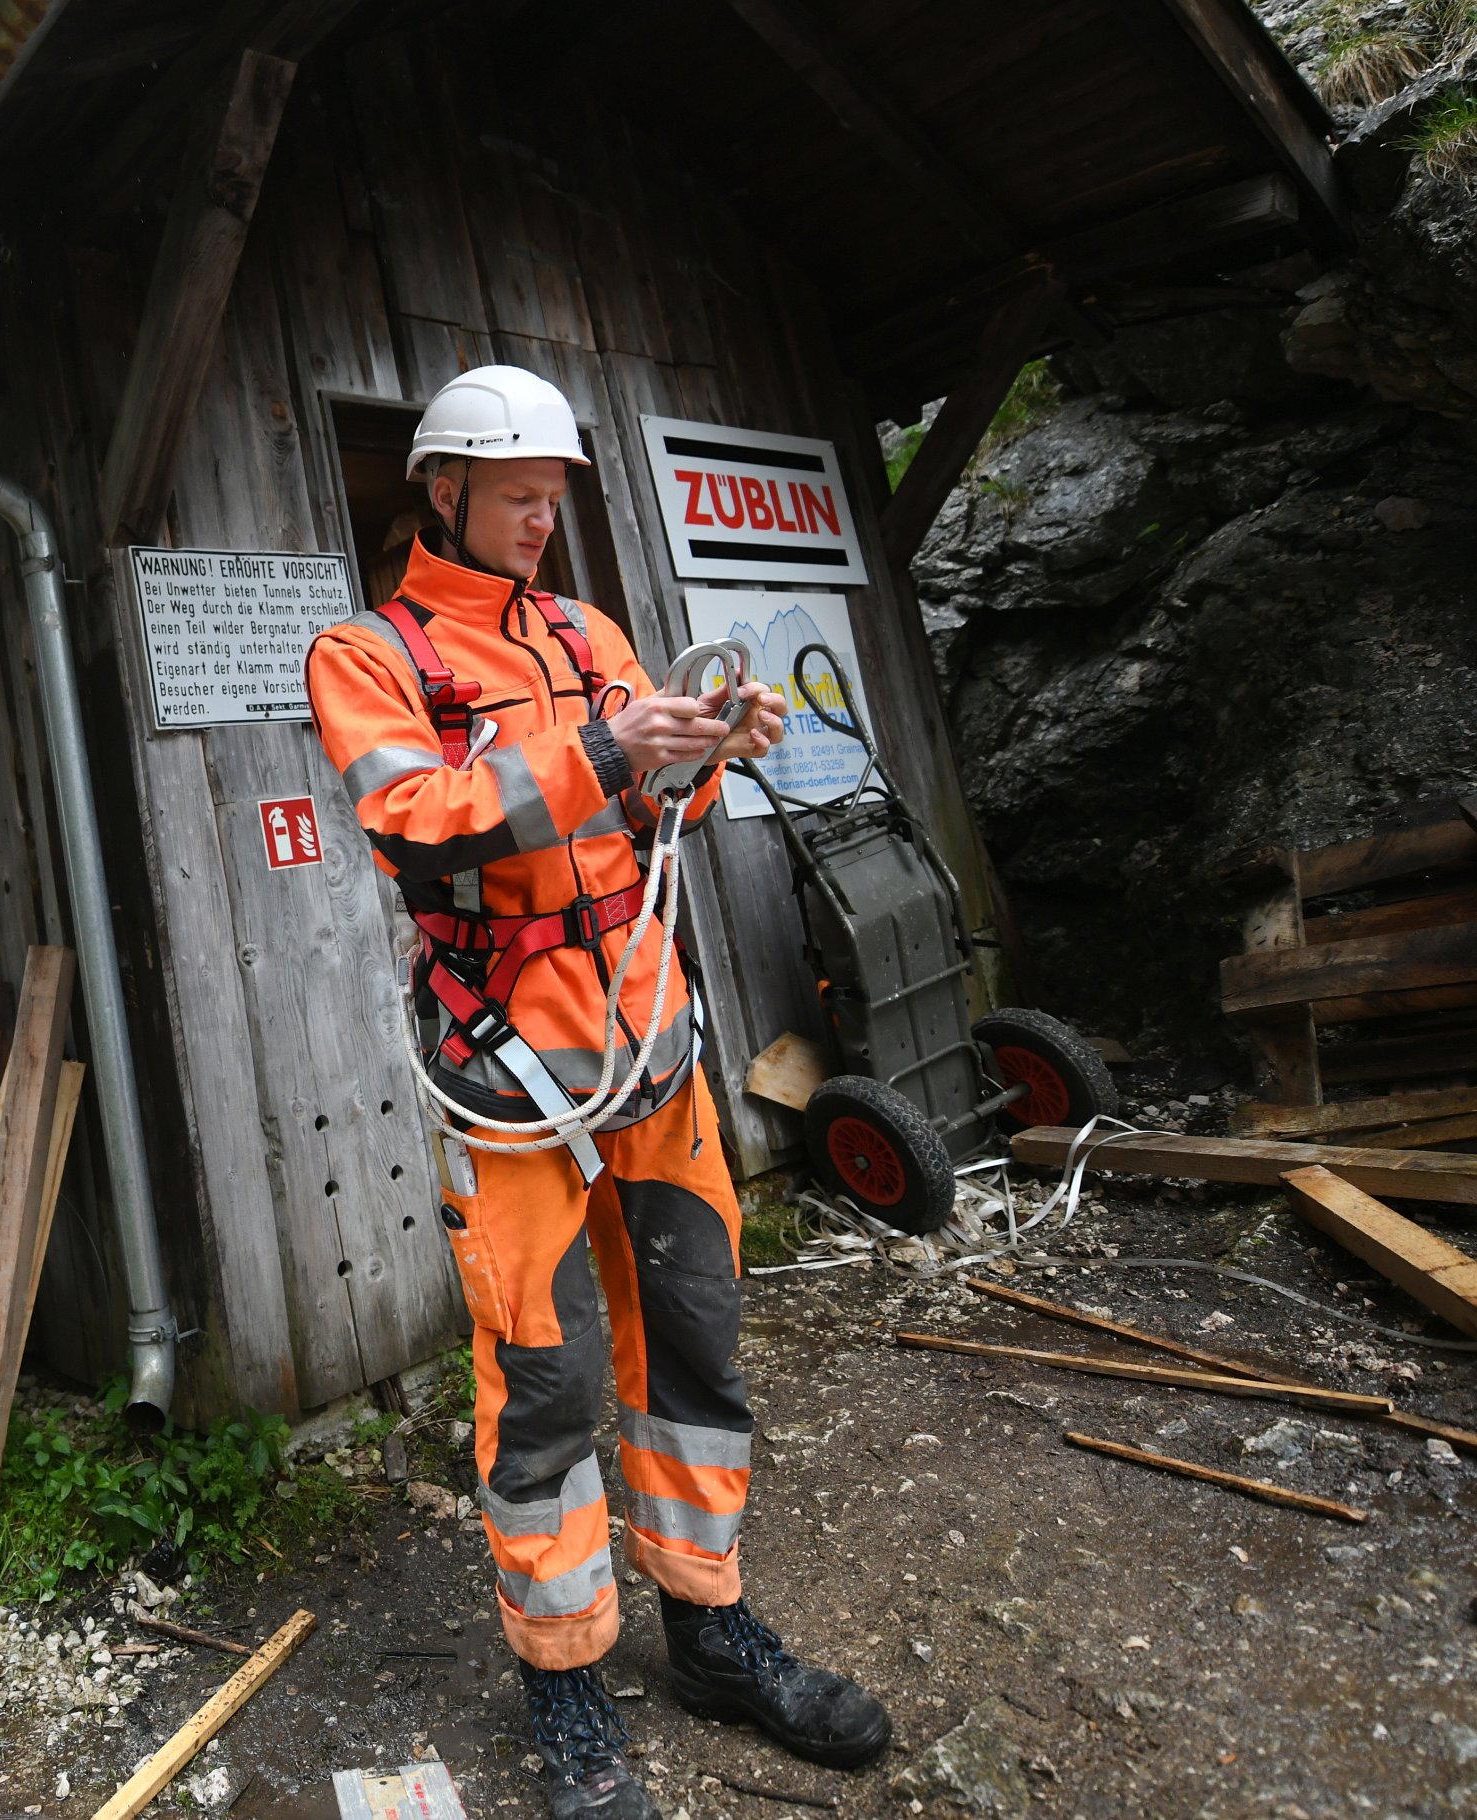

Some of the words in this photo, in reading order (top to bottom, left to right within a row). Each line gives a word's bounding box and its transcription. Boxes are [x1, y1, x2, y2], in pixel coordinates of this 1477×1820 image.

[674, 470, 842, 536] ZÜBLIN
[220, 557, 276, 579] ERHÖHTE
[145, 581, 162, 595] Bei
[167, 582, 216, 597] Unwetter
[224, 583, 257, 597] bieten
[263, 584, 301, 598] Tunnels
[309, 585, 346, 599] Schutz.
[147, 599, 166, 613] Der
[170, 600, 195, 618] Weg
[203, 600, 233, 615] durch
[237, 602, 253, 615] die
[259, 602, 294, 615] Klamm
[301, 602, 349, 616] erschließt
[151, 621, 181, 634] einen
[186, 620, 206, 634] Teil
[213, 621, 244, 635] wilder
[251, 621, 303, 638] Bergnatur.
[309, 621, 324, 634] Der
[154, 641, 179, 655] wird
[188, 641, 231, 658] ständig
[240, 640, 306, 655] unterhalten.
[157, 661, 206, 679] Eigenart
[214, 660, 230, 674] der
[237, 660, 274, 675] Klamm
[280, 659, 301, 673] muß
[160, 682, 214, 696] Besucher
[222, 681, 257, 698] eigene
[163, 701, 210, 715] werden.
[761, 763, 793, 776] Telefon
